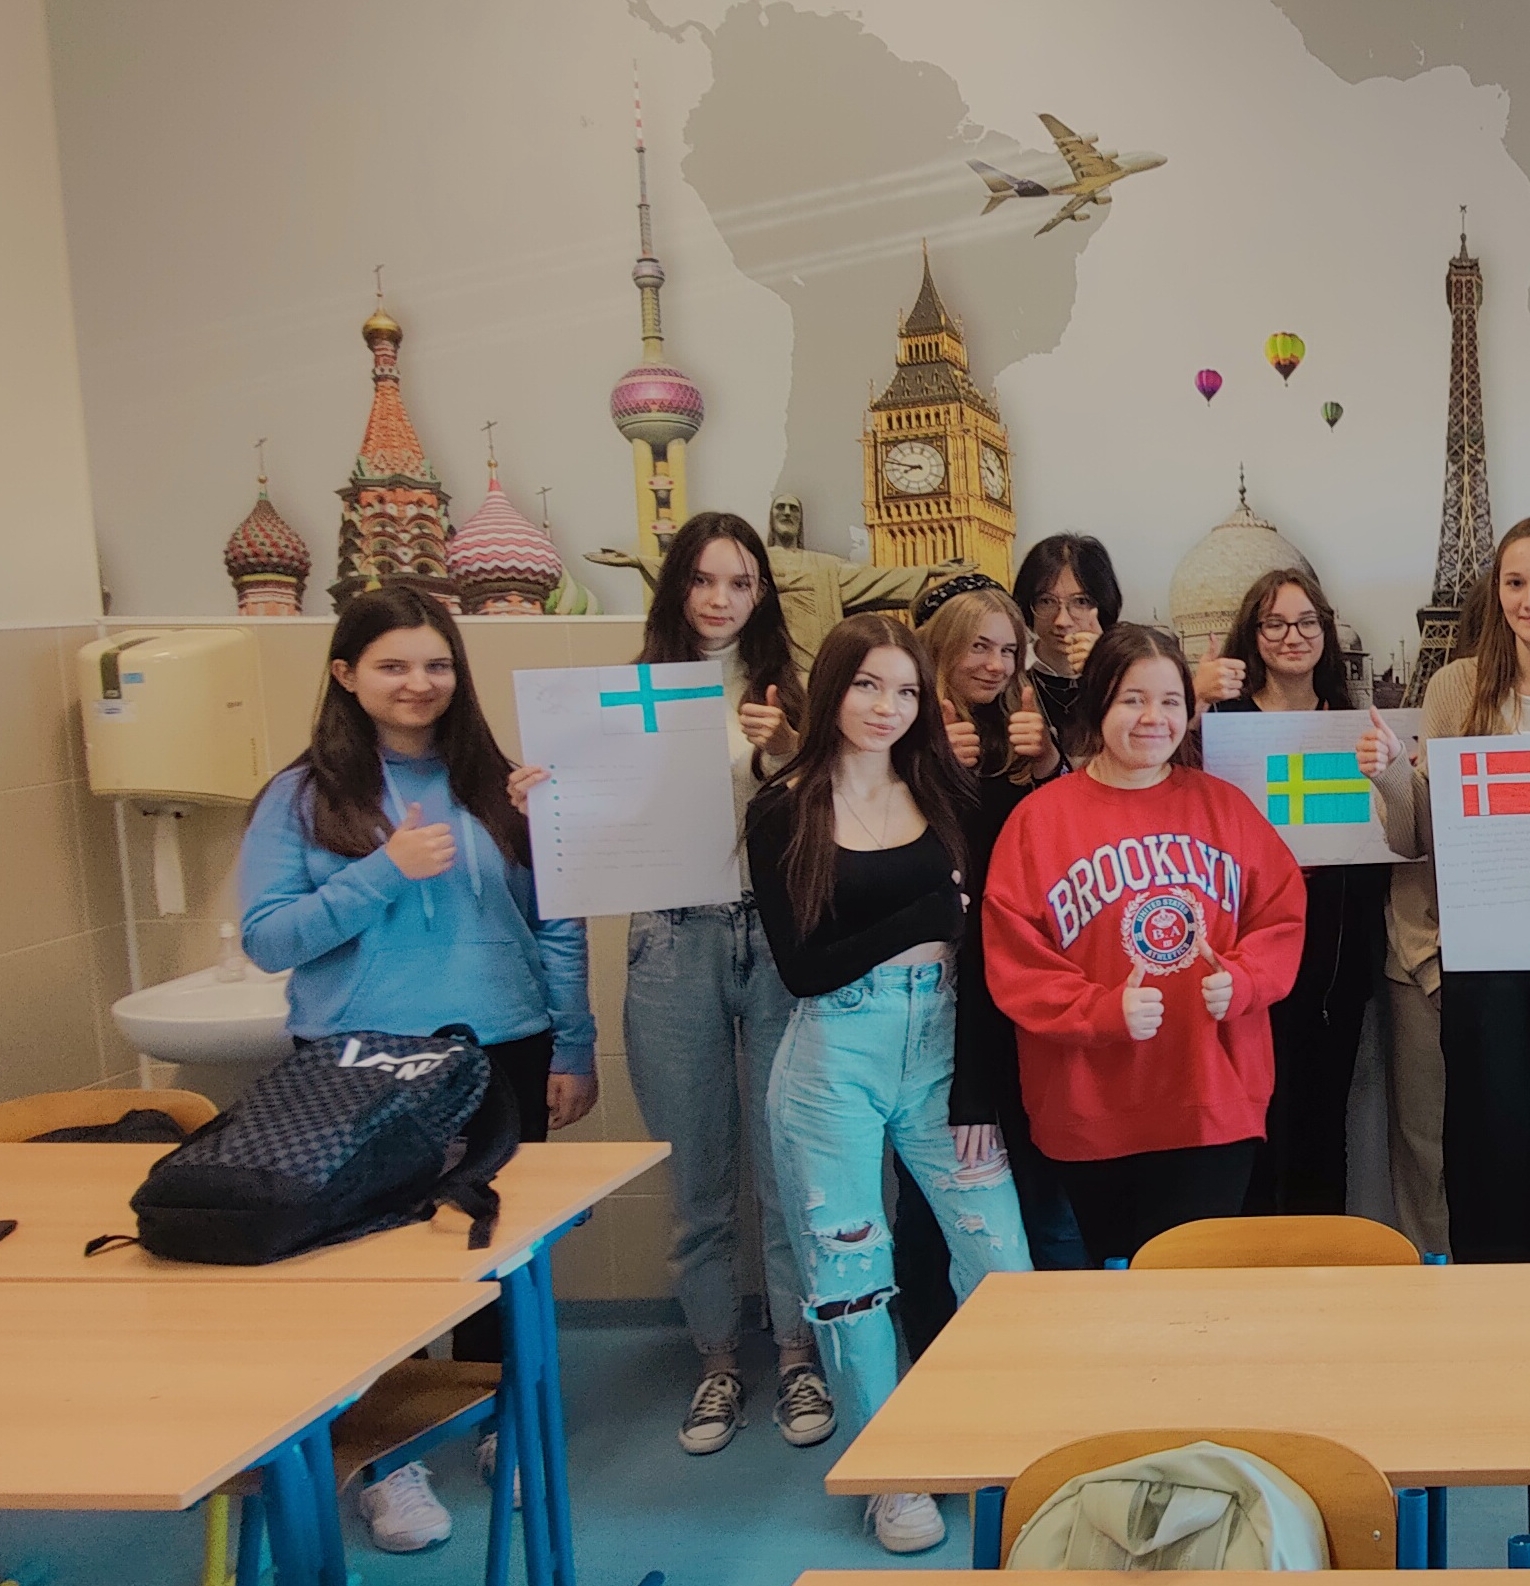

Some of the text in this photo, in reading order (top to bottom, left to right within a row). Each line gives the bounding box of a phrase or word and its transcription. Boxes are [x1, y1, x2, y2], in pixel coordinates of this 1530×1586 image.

[1048, 834, 1240, 949] BROOKLYN
[1136, 898, 1190, 922] UNITED STATES
[1145, 942, 1190, 961] ATHLETICS
